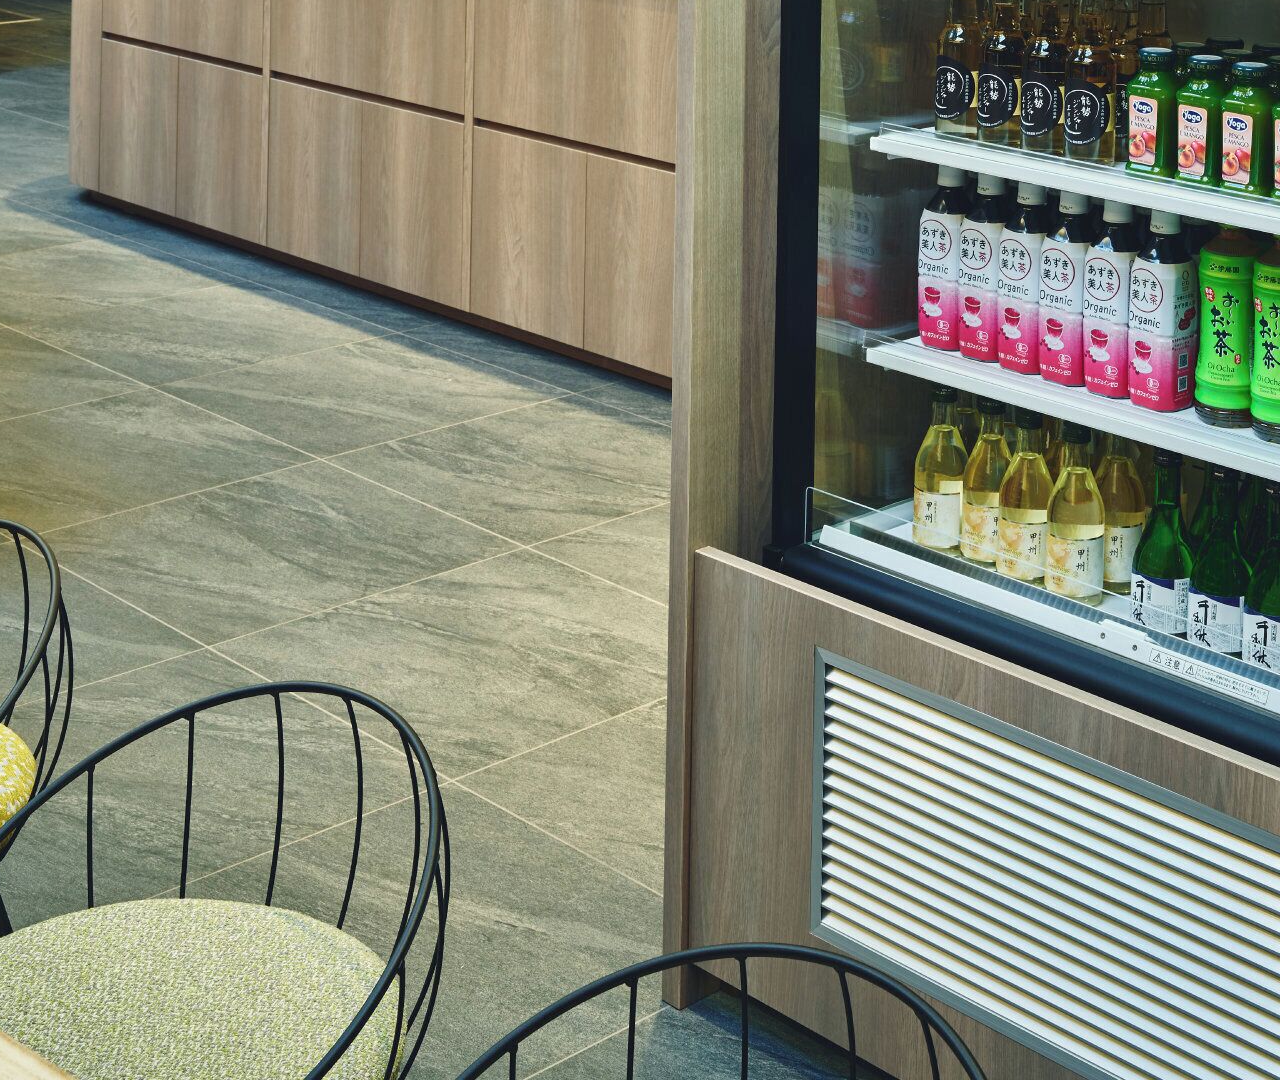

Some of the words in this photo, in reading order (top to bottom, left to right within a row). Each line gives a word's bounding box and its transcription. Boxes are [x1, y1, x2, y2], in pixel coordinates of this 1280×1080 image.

[1134, 101, 1151, 113] Yoga
[1135, 122, 1155, 130] MANGO
[1228, 117, 1246, 130] Yoga
[921, 226, 947, 241] あずき
[921, 239, 947, 253] 美人茶
[961, 235, 986, 250] あずき
[961, 249, 987, 263] 美人茶
[1001, 245, 1026, 260] あずき
[919, 258, 949, 276] Organic
[1000, 259, 1026, 274] 美人茶
[1043, 254, 1069, 271] あずき
[959, 269, 990, 285] Organic
[1043, 269, 1069, 284] 美人茶
[1088, 264, 1115, 280] あずき
[1087, 279, 1115, 294] 美人茶
[1132, 274, 1157, 291] あずき
[1131, 289, 1158, 305] 美人茶
[1216, 364, 1235, 373] Ocha
[925, 501, 933, 523] 甲州
[1028, 532, 1038, 555] 甲州
[1164, 656, 1180, 670] 注意
